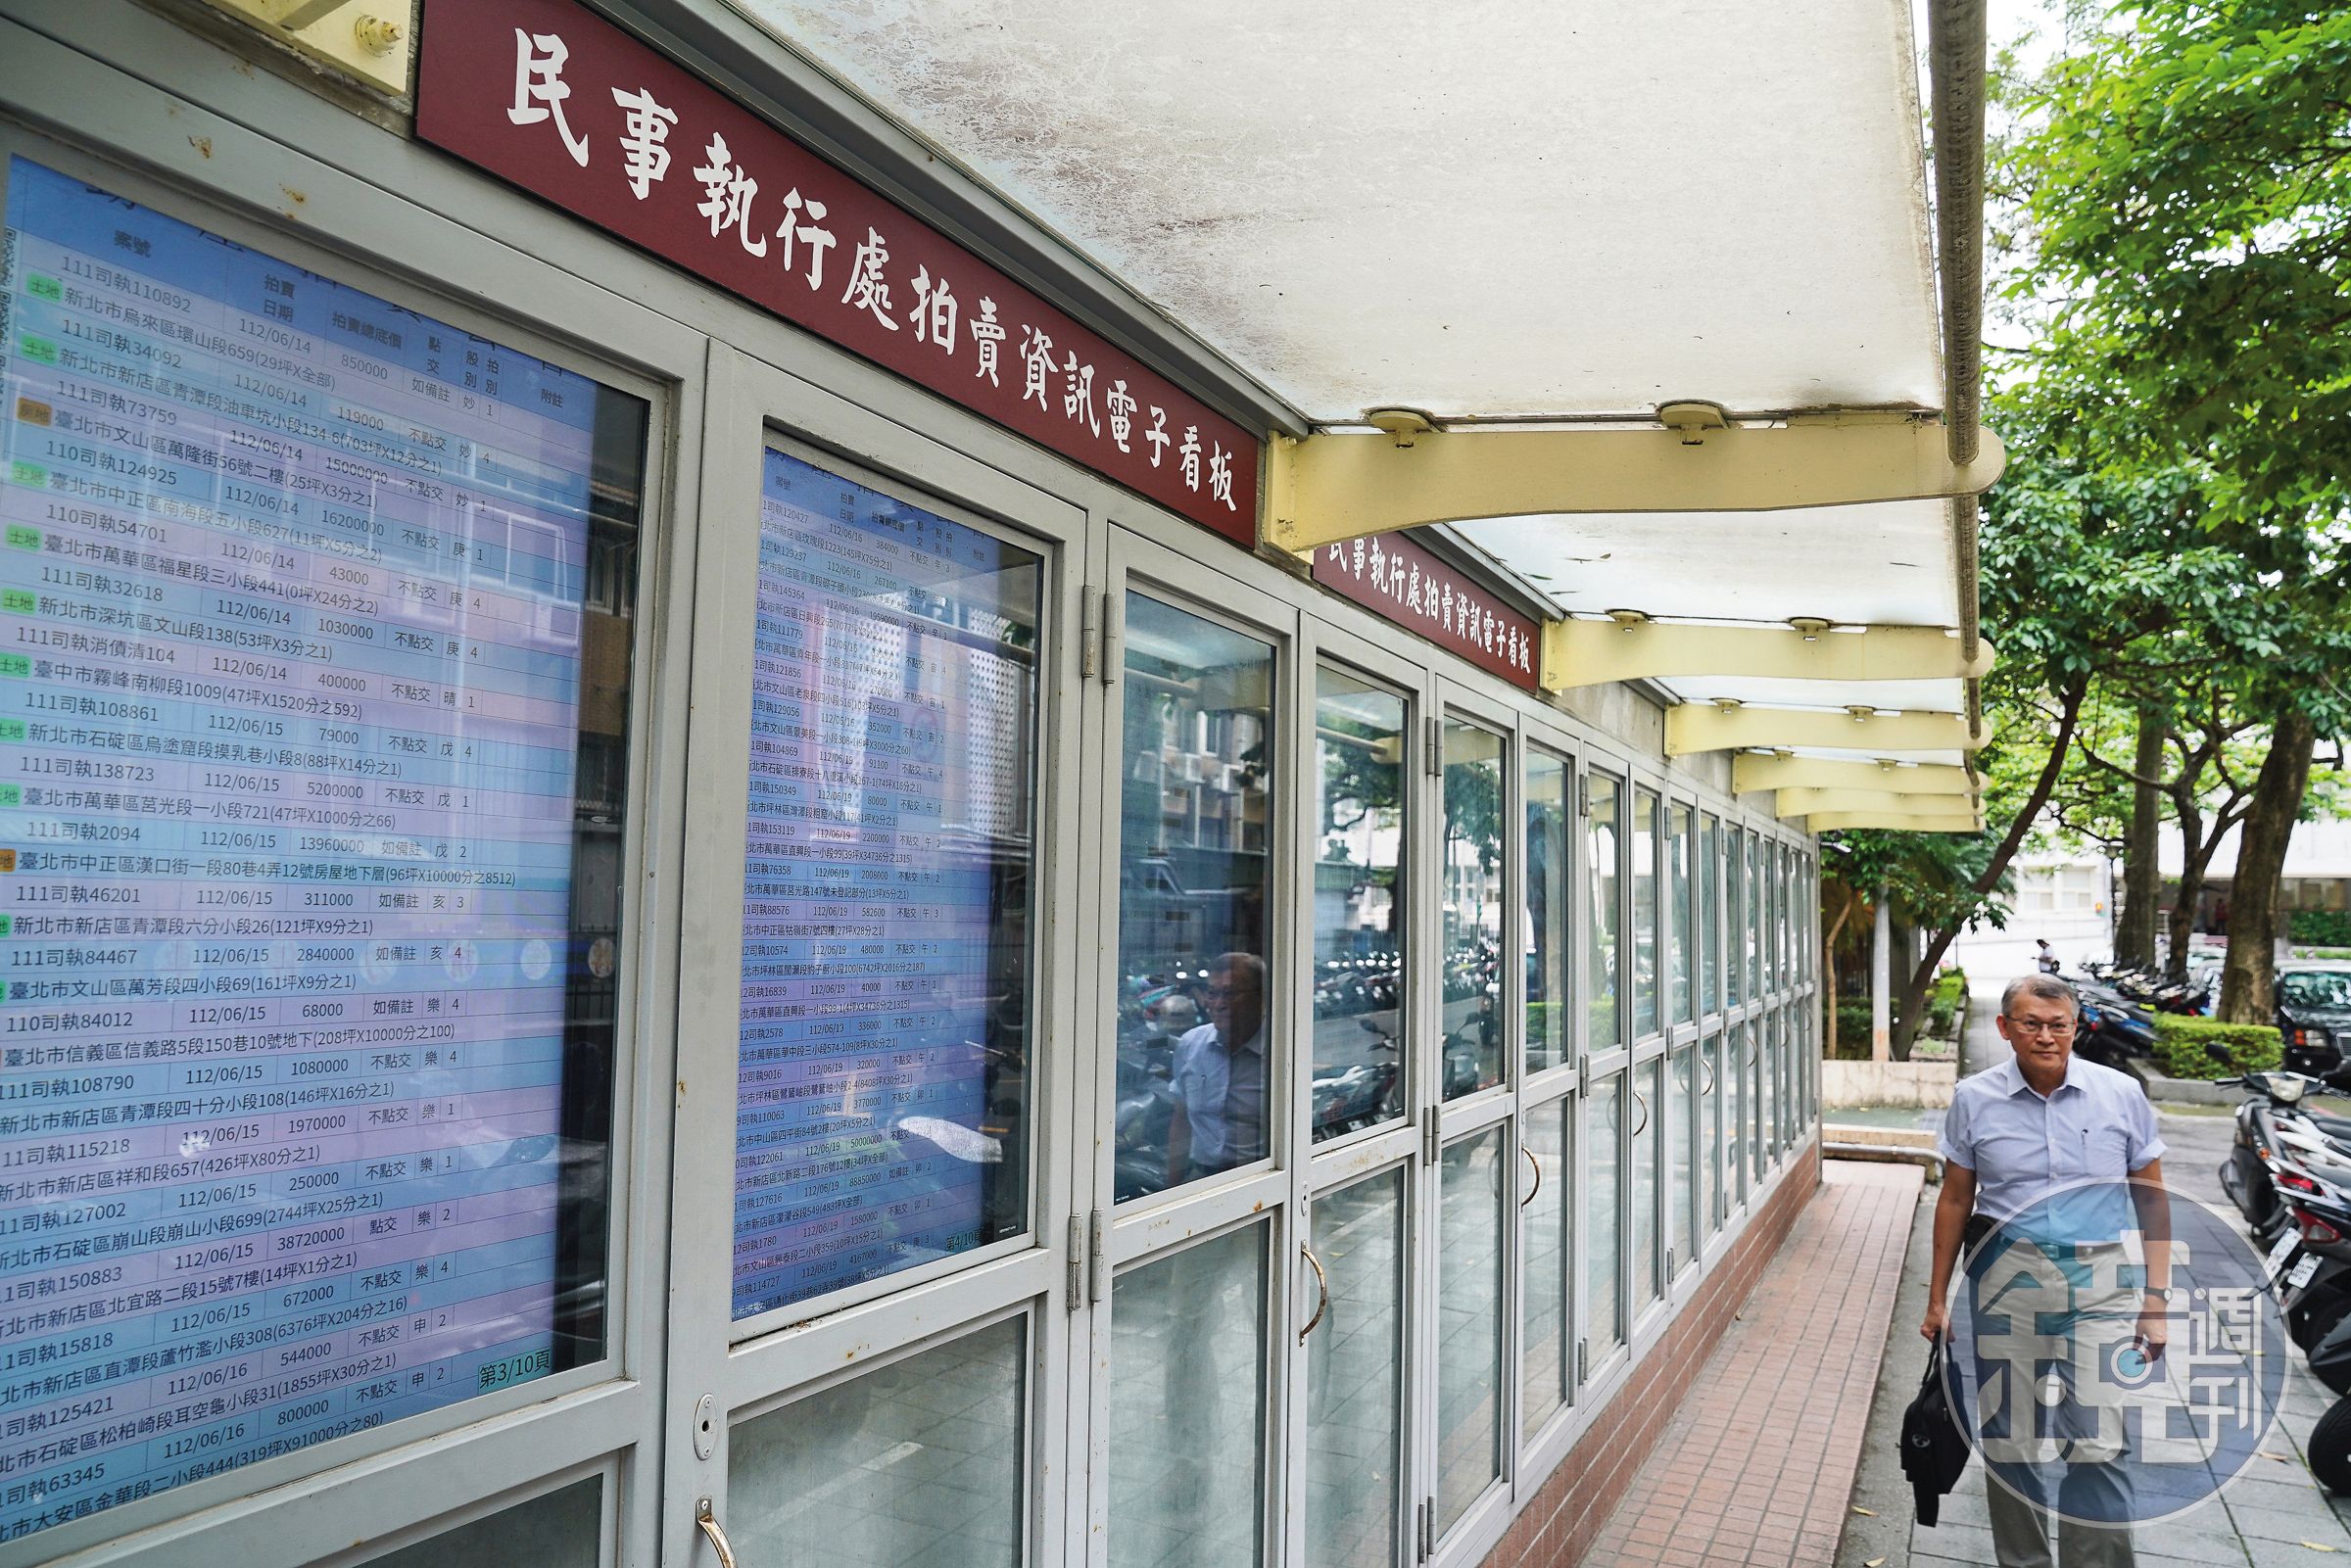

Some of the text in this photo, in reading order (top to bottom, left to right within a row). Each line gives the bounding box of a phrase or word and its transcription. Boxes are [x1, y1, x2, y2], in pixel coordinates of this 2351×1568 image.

[113, 227, 152, 260] 案號
[264, 272, 296, 300] 拍賣
[507, 27, 1236, 511] 民事執行處拍賣資訊電子看板
[61, 255, 451, 404] 111司執110892 112/06/14 850000 如備註
[263, 297, 294, 323] 日期
[331, 309, 403, 351] 拍賣總底價
[64, 287, 336, 392] 新北市烏來區環山段659(29坪X全部)
[61, 317, 448, 453] 111司執34092 112/06/14 119000 不點交
[540, 387, 563, 408] 附註
[58, 347, 442, 476] 新北市新店區青潭段油車坑小段134-6(703坪X12分之1)
[53, 408, 378, 510] 臺北市文山區萬隆街56號二樓(25坪X3分之1)
[56, 378, 445, 502] 111司執73759 112/06/14 15000000 不點交
[46, 438, 441, 551] 110司執124925 112/06/14 16200000 不點交
[48, 470, 382, 563] 臺北市中正區南海段五小段627(11坪X5分之2)
[46, 500, 438, 601] 110司執54701 112/06/14 43000 不點交
[876, 539, 898, 555] 384000
[43, 532, 379, 615] 臺北市萬華區福星段三小段441(0坪X24分之2)
[37, 594, 333, 661] 新北市深坑區文山段138(53坪X3分之1)
[41, 563, 435, 651] 111司執32618 112/06/14 1030000 不點交
[16, 623, 431, 702] 111司執消債清104 112/06/14 400000 不點交
[32, 658, 362, 719] 臺中市霧峰南柳段1009(47坪X1520分之592)
[24, 689, 428, 753] 111司執108861 112/06/15 79000 不點交
[27, 722, 403, 777] 新北市石碇區烏塗窟段摸乳巷小段8(88坪X14分之1)
[19, 753, 425, 805] 111司執138723 112/06/15 5200000 不點交
[23, 785, 397, 830] 臺北市萬華區莒光段一小段721(47坪X1000分之66)
[26, 819, 422, 857] 111司執2094 112/06/15 13960000 如備註
[17, 851, 516, 886] 臺北市中正區漢口街一段80巷4弄12號房屋地下層(96坪X10000分之8512)
[15, 883, 420, 910] 111司執46201 112/06/15 311000 如備註
[812, 905, 917, 919] 112/06/19 582600 不點交
[12, 916, 373, 936] 新北市新店區青潭段六分小段26(121坪X9分之1)
[10, 945, 417, 969] 111司執84467 112/06/15 2840000 如備註
[811, 943, 916, 956] 112/06/19 480000 不點交
[7, 974, 357, 1002] 臺北市文山區萬芳段四小段69(161坪X9分之1)
[5, 998, 414, 1035] 110司執84012 112/06/15 68000 如備註
[808, 1017, 913, 1036] 112/06/19 336000 不點交
[3, 1022, 456, 1069] 臺北市信義區信義路5段150巷10號地下(208坪X10000分之100)
[807, 1061, 842, 1076] 112/06/19
[857, 1058, 881, 1069] 320000
[891, 1053, 912, 1067] 不點交
[184, 1064, 263, 1090] 112/06/15
[290, 1058, 349, 1077] 1080000
[369, 1051, 411, 1072] 不點交
[0, 1079, 395, 1136] 新北市新店區青潭段四十分小段108(146坪X16分之1)
[806, 1100, 841, 1117] 112/06/19
[853, 1095, 881, 1109] 3770000
[890, 1090, 911, 1105] 不點交
[180, 1122, 260, 1151] 112/06/15
[287, 1113, 347, 1135] 1970000
[366, 1105, 409, 1127] 不點交
[804, 1139, 840, 1157] 112/06/19
[850, 1133, 882, 1148] 50000000
[177, 1181, 257, 1212] 112/06/15
[287, 1169, 340, 1192] 250000
[363, 1159, 408, 1183] 不點交
[803, 1178, 840, 1198] 112/06/19
[849, 1171, 881, 1187] 88850000
[802, 1218, 839, 1238] 112/06/19
[850, 1210, 878, 1226] 1580000
[888, 1202, 908, 1218] 不點交
[944, 1226, 981, 1252] 第4/10頁
[0, 1213, 399, 1305] 1司執150883 112/06/15 38720000 點交
[801, 1248, 877, 1279] 112/06/19 4167000
[0, 1249, 358, 1339] 北市新店區北宜路二段15號7樓(14坪X1分之1)
[0, 1266, 403, 1372] 1司執15818 112/06/15 672000 不點交
[167, 1359, 248, 1399] 112/06/16
[278, 1340, 332, 1368] 544000
[357, 1321, 401, 1353] 不點交
[479, 1347, 551, 1390] 第3/10頁
[164, 1420, 245, 1462] 112/06/16
[276, 1398, 329, 1427] 800000
[354, 1376, 399, 1410] 不點交
[412, 1370, 426, 1390] 申
